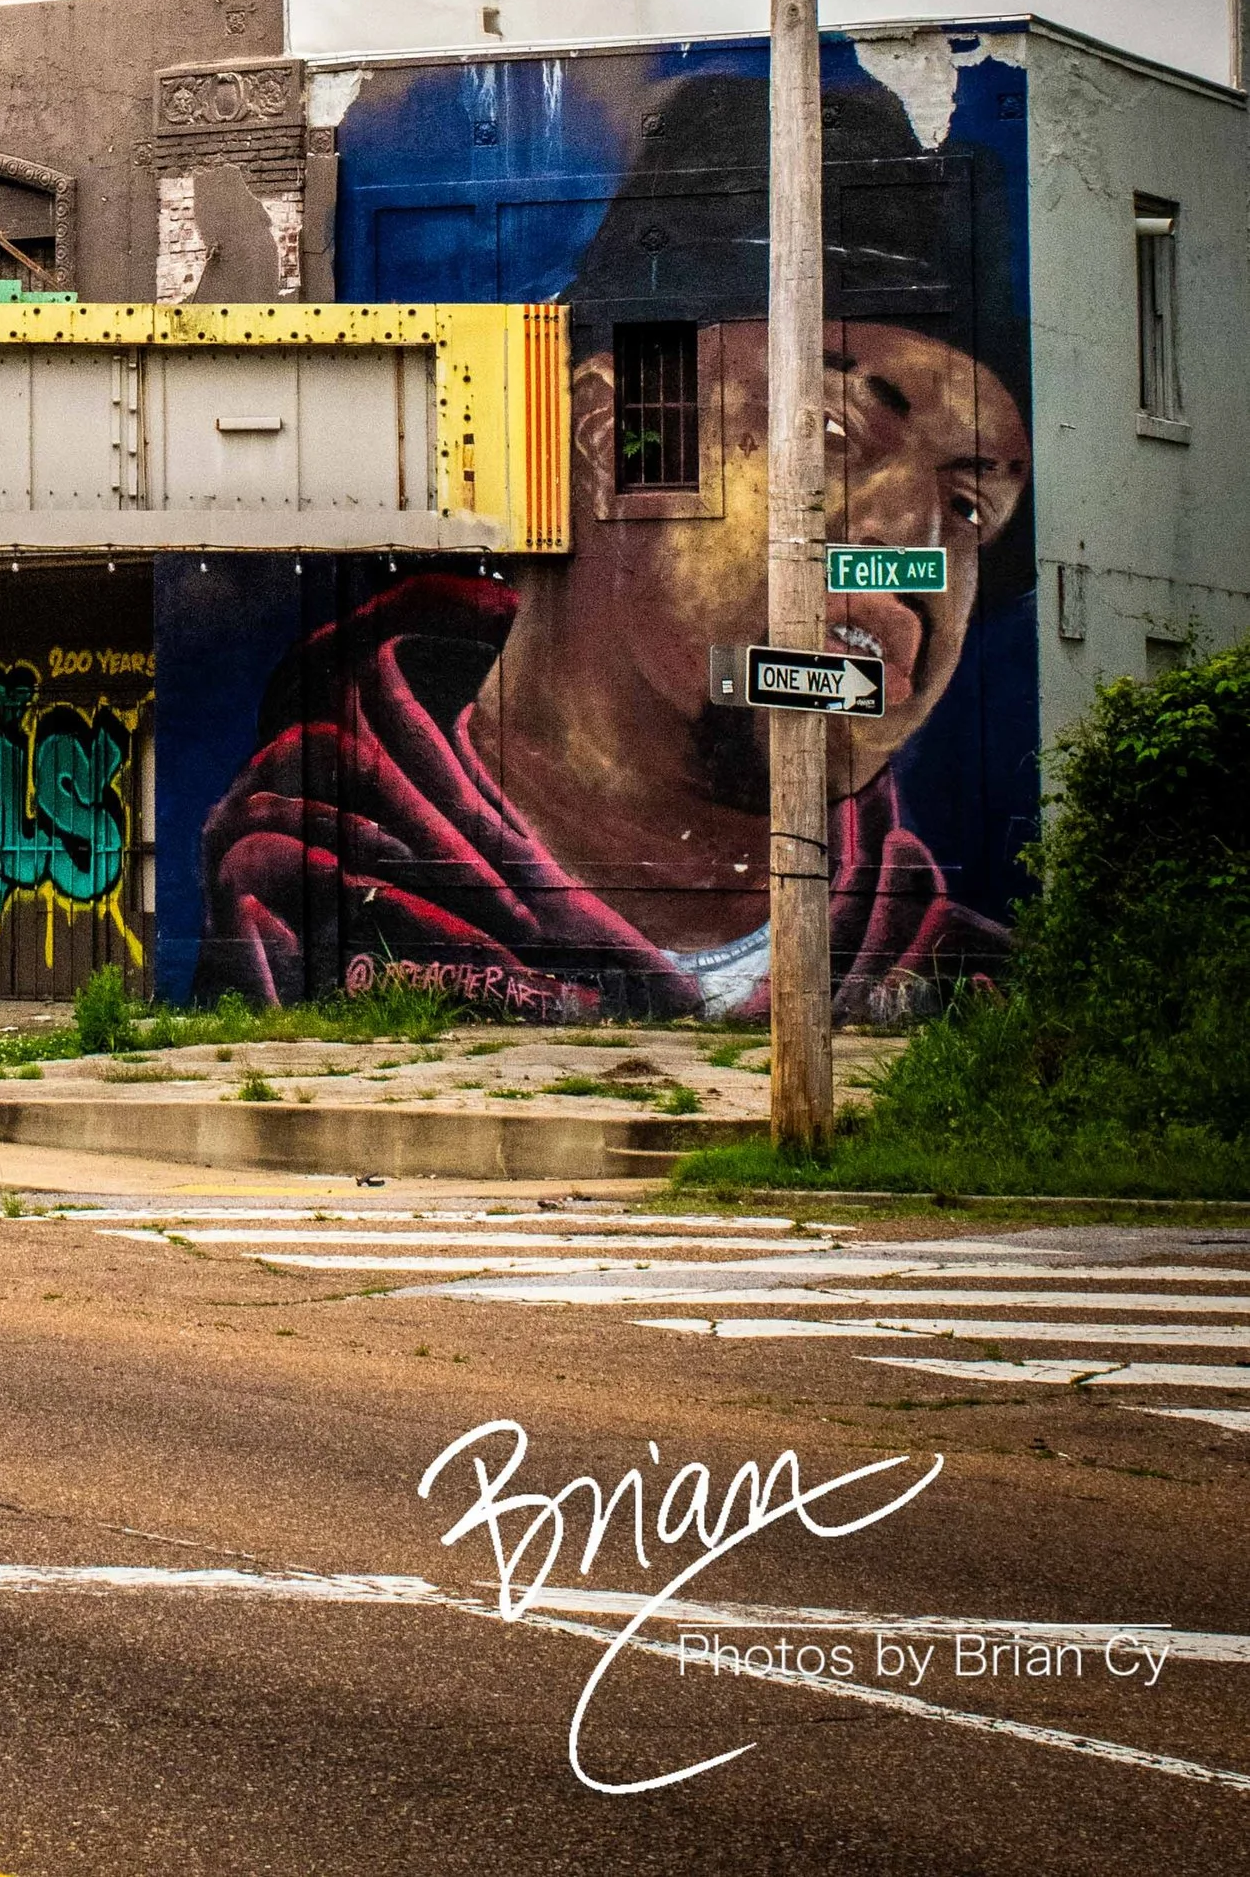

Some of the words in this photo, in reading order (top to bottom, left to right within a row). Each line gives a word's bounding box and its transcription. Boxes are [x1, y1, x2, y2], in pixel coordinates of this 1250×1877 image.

[838, 555, 900, 586] Felix
[907, 562, 937, 579] AVE
[49, 646, 93, 677] 200
[763, 666, 800, 690] ONE
[807, 670, 844, 694] WAY
